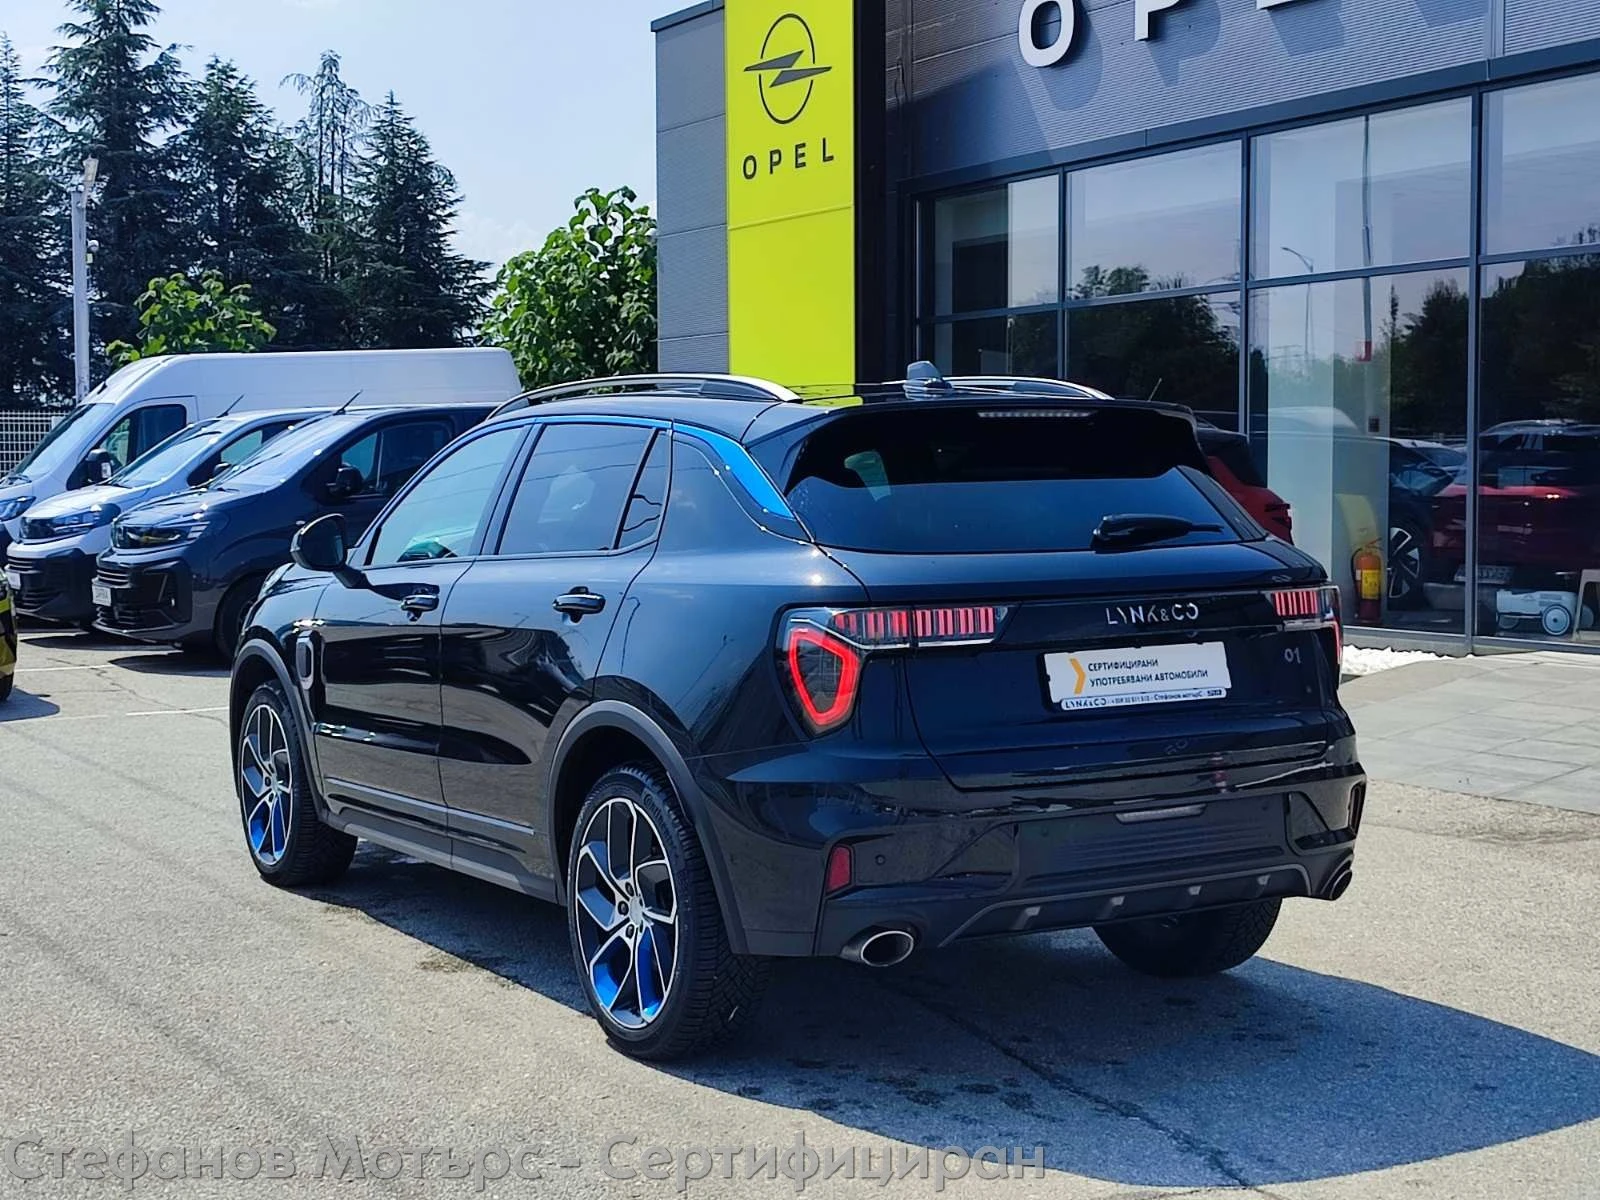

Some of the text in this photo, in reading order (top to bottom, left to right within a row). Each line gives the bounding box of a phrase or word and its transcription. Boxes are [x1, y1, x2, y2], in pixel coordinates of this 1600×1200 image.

[1019, 0, 1297, 67] OP
[743, 138, 834, 180] OPEL
[1284, 647, 1301, 664] 01
[1088, 658, 1159, 672] СЕРТИФИЦИРАНИ
[1089, 670, 1209, 688] УПОТРЕБЯВАНИ АВТОМОБИЛИ
